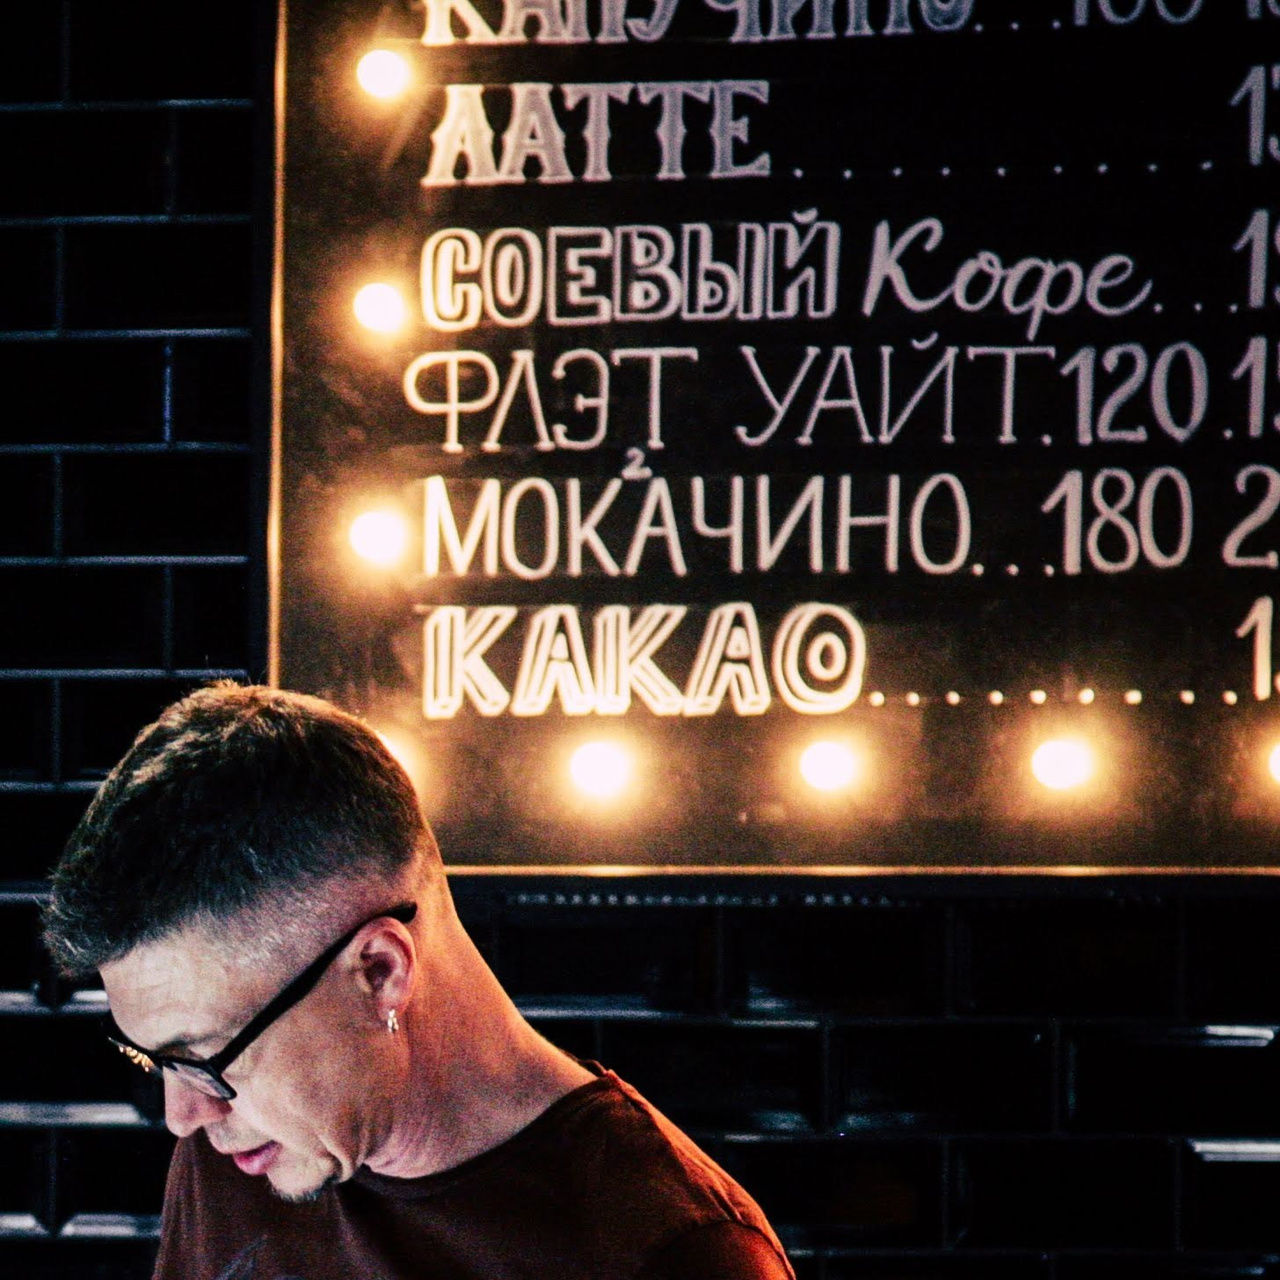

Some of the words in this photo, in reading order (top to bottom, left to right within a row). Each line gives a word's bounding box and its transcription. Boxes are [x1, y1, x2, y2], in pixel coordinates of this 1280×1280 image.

[421, 80, 771, 187] ЛАТТЕ
[421, 208, 841, 332] СОЕВЫЙ
[862, 217, 1153, 342] Кофе
[403, 346, 699, 452] ФЛЭТ
[734, 331, 1056, 448] УАЙТ
[422, 472, 972, 580] МОКАЧИНО
[1041, 466, 1194, 576] 180
[423, 601, 867, 720] КАКАО
